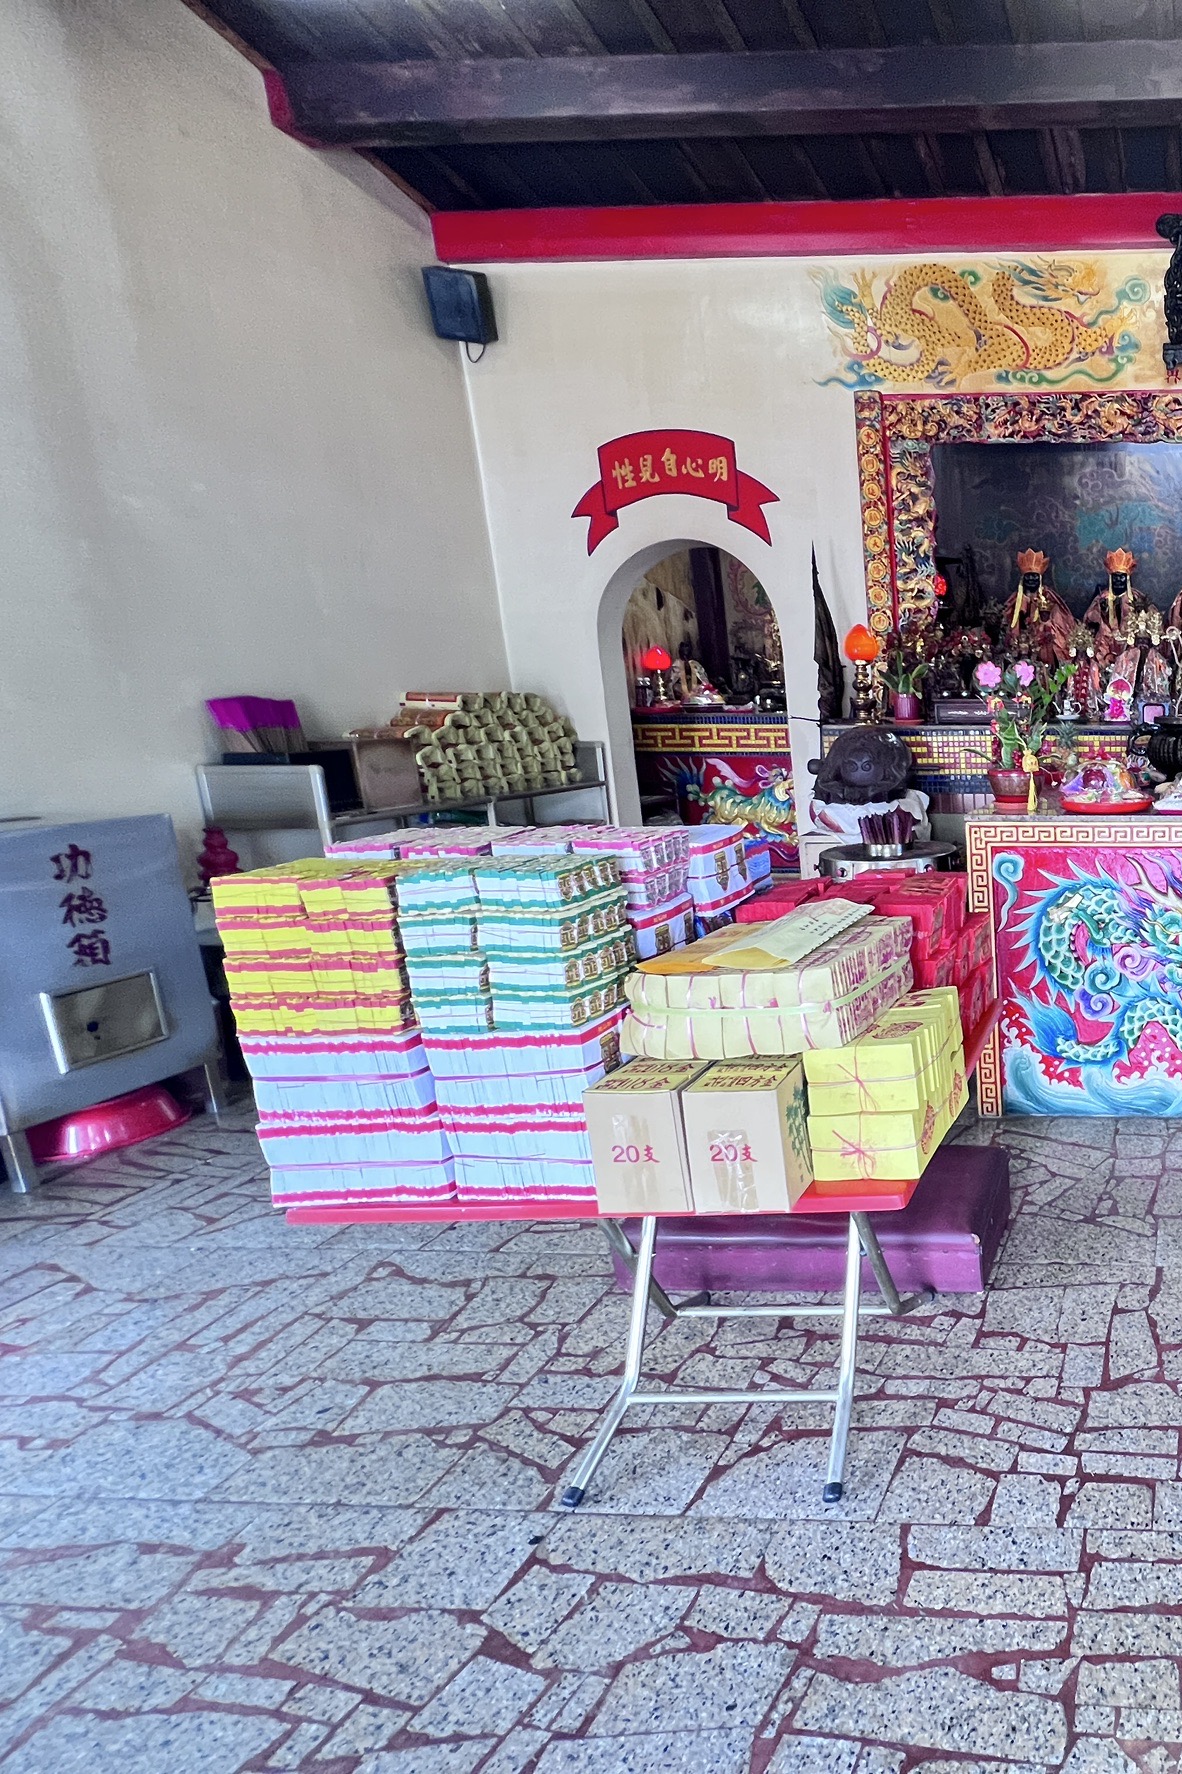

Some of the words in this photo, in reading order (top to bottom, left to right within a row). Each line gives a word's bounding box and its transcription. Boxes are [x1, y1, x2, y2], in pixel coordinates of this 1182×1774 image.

[50, 843, 112, 968] 功德箱
[611, 1144, 661, 1163] 20支
[709, 1143, 758, 1163] 20支
